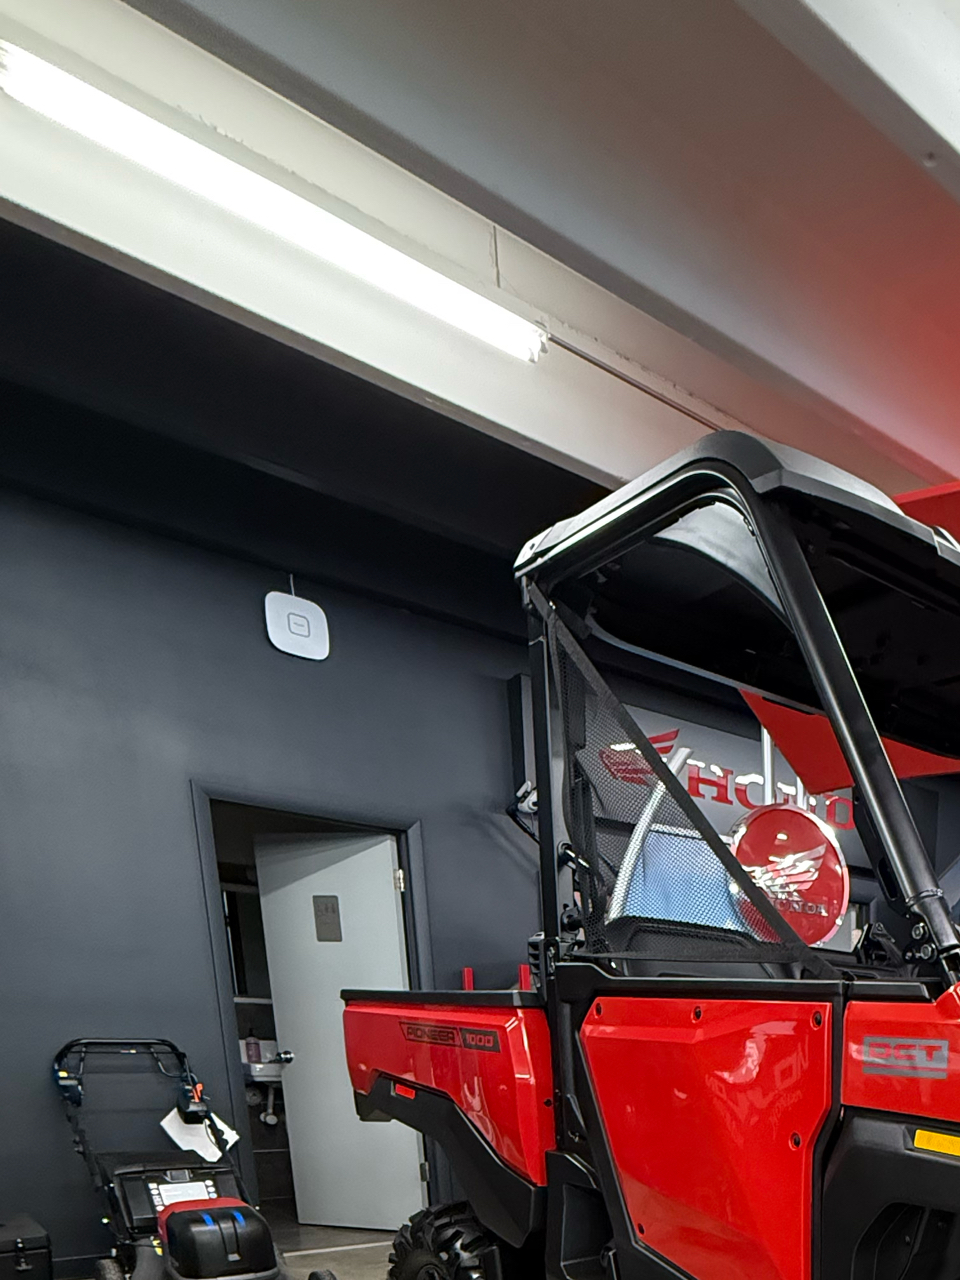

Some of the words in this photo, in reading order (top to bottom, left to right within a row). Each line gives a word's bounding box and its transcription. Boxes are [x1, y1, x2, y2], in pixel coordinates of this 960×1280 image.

[407, 1026, 456, 1043] PIONEER
[465, 1033, 494, 1047] 1000
[868, 1041, 943, 1063] DCT
